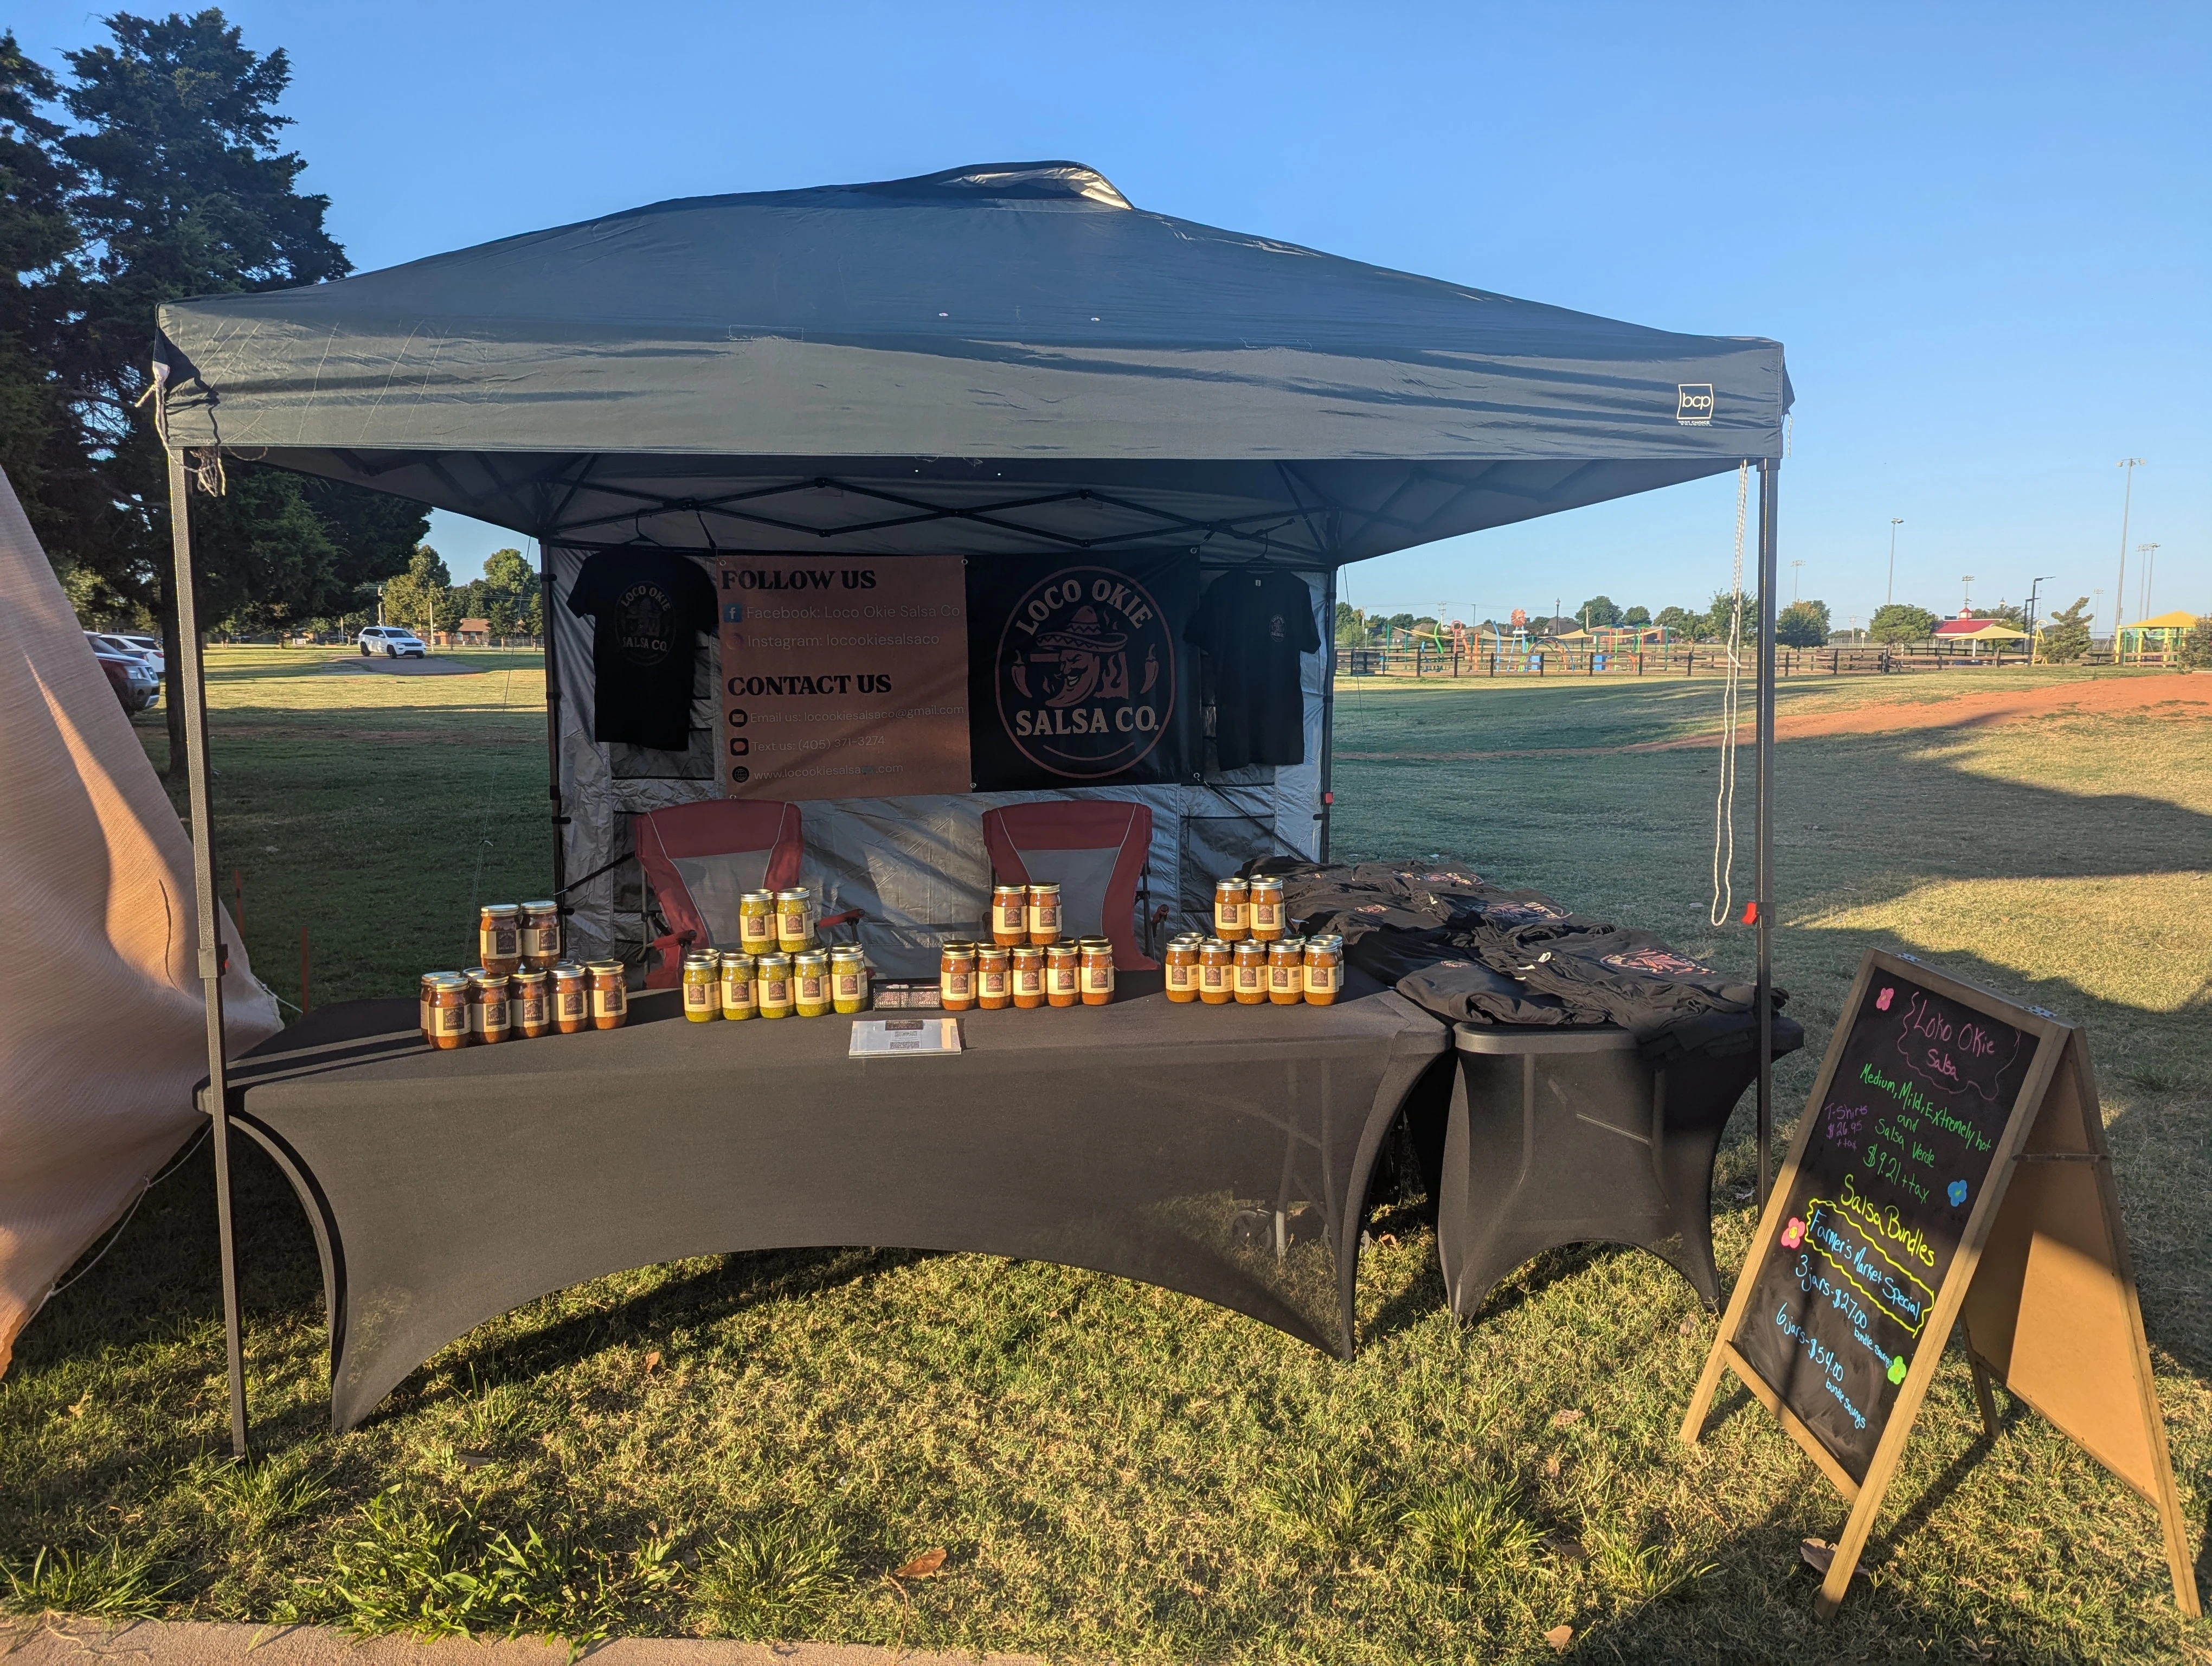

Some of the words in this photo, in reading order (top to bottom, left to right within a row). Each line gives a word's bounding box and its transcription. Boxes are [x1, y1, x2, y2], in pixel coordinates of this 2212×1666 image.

[1682, 393, 1711, 410] bcp
[722, 570, 835, 589] FOLLOW
[841, 570, 876, 589] US
[621, 585, 646, 607] LOCO
[649, 587, 671, 611] OKIE
[1016, 579, 1082, 636] LOCO
[1091, 579, 1153, 629] OKIE
[747, 606, 820, 619] Facebook:
[825, 606, 859, 619] Loco
[864, 605, 896, 618] Okie
[900, 605, 936, 618] Salsa
[941, 605, 960, 617] Co
[622, 637, 649, 649] SALSA
[748, 635, 822, 650] Instagram:
[827, 633, 940, 646] locookiesalsaco
[727, 675, 851, 696] CONTACT
[856, 674, 892, 694] US
[750, 712, 781, 723] Email
[786, 714, 801, 722] us:
[804, 704, 964, 722] locookiesalsaco@gmail.com
[1016, 707, 1109, 736] SALSA
[1115, 705, 1160, 732] CO.
[752, 741, 776, 751] Text
[781, 742, 795, 751] us:
[799, 738, 831, 752] (405)
[834, 735, 885, 748] 371-3274
[754, 764, 903, 780] www.locookiesalsa.com
[1914, 999, 1952, 1041] Loko
[1926, 1049, 1959, 1081] Salsa
[1860, 1063, 1897, 1099] Medium,
[1899, 1081, 1924, 1113] Mild,
[1925, 1101, 1975, 1149] Extremely
[1975, 1130, 1991, 1151] hot
[1898, 1114, 1919, 1132] and
[1875, 1118, 1904, 1150] Salsa
[1912, 1141, 1934, 1168] Verde
[1863, 1143, 1901, 1185] $9.21
[1841, 1174, 1885, 1235] Salsa
[1885, 1205, 1934, 1267] Bundles
[1796, 1254, 1808, 1277] 3
[1810, 1209, 1852, 1260] Farmer's
[1882, 1277, 1920, 1321] Special
[1776, 1302, 1787, 1325] 6
[1854, 1327, 1873, 1350] bundle
[1826, 1377, 1844, 1403] bundle
